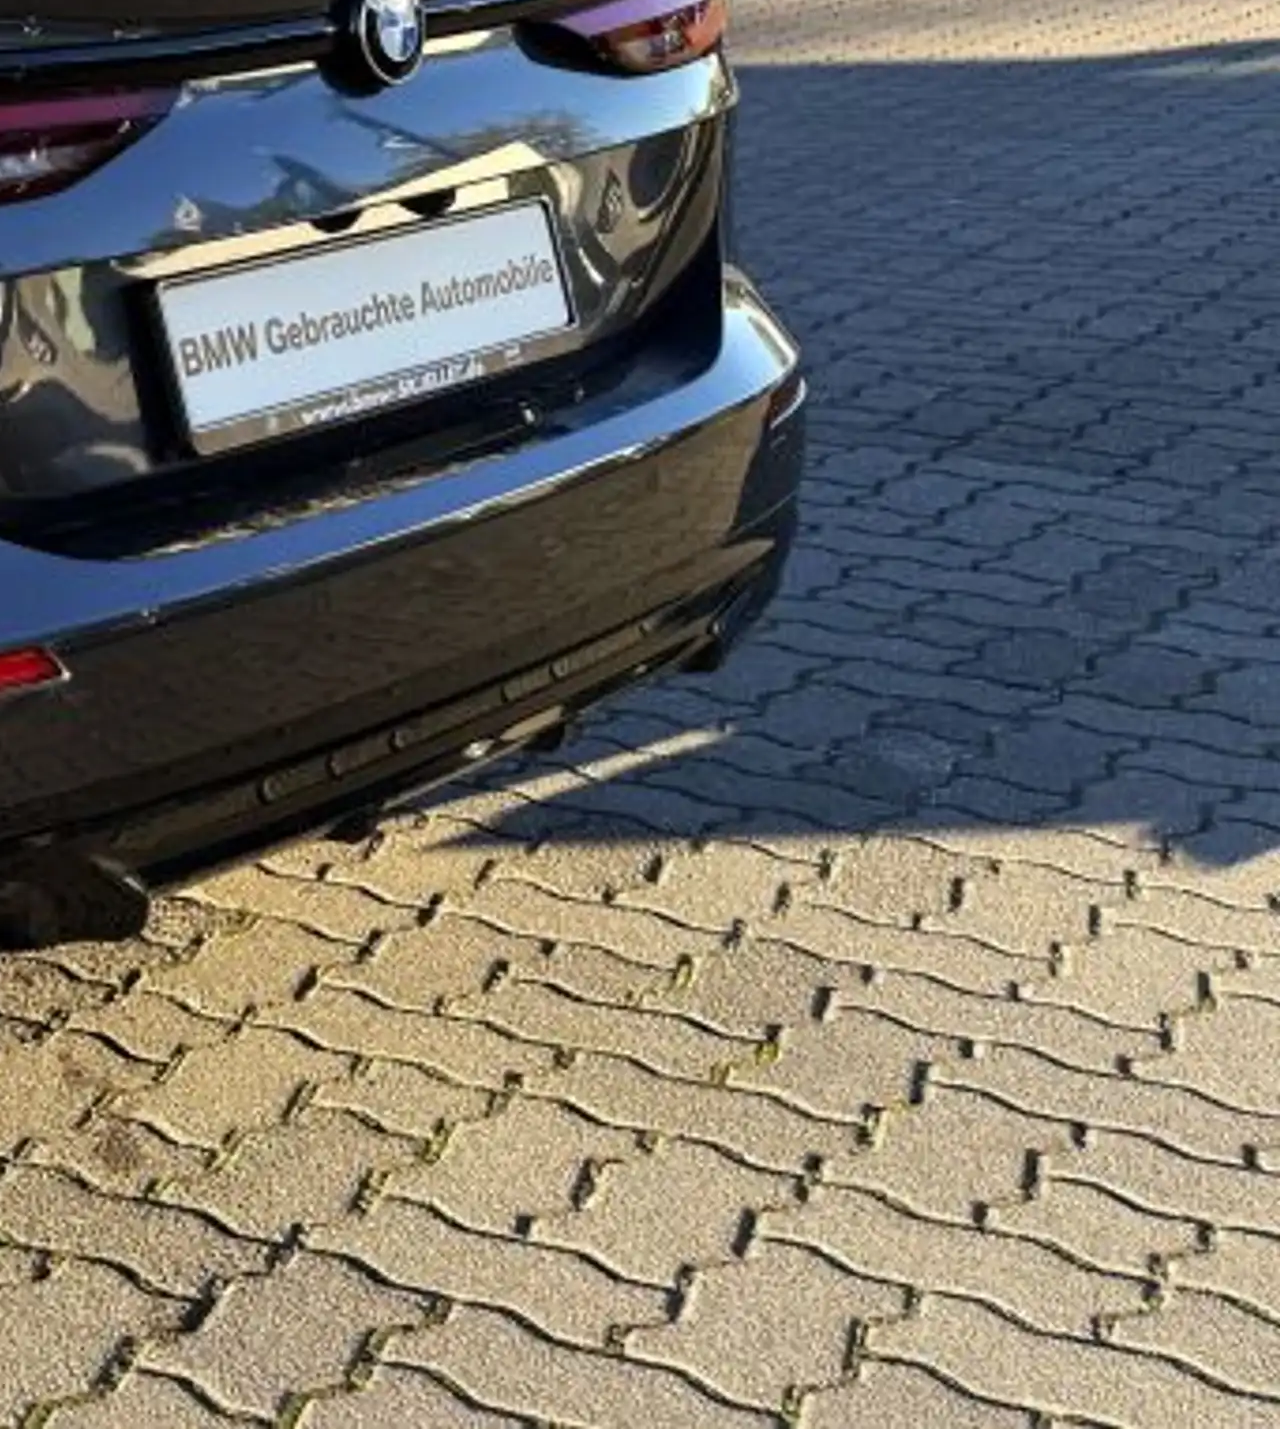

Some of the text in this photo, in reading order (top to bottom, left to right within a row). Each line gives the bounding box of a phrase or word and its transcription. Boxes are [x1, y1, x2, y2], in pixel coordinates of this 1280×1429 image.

[178, 254, 554, 378] BMW Gebrauchte Automobile
